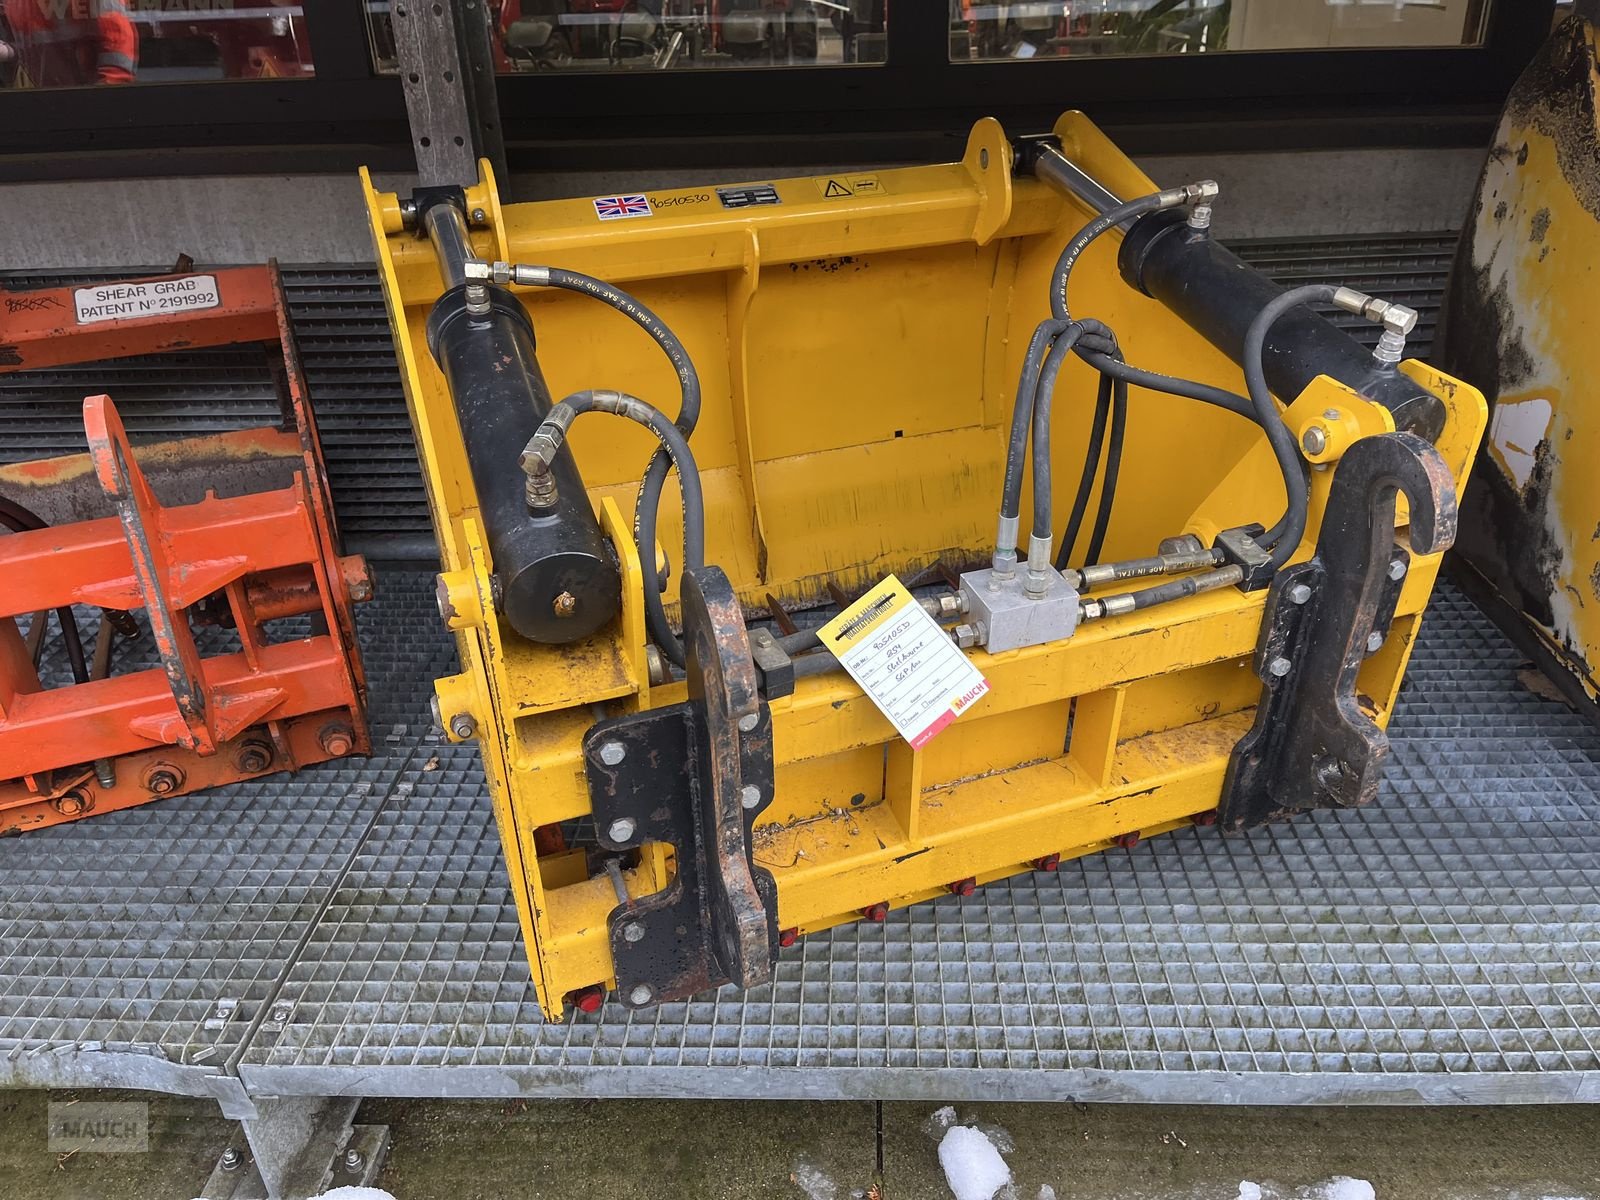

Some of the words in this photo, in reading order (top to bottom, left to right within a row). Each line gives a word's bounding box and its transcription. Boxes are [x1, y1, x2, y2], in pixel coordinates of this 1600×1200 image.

[650, 194, 711, 209] 90510530
[96, 287, 146, 302] SHEAR
[154, 280, 196, 295] GRAB
[603, 290, 619, 301] SAE
[81, 301, 134, 318] PATENT
[159, 292, 215, 308] 2191992
[627, 303, 636, 313] 10
[1136, 567, 1146, 576] IN
[954, 682, 984, 709] MAUCH
